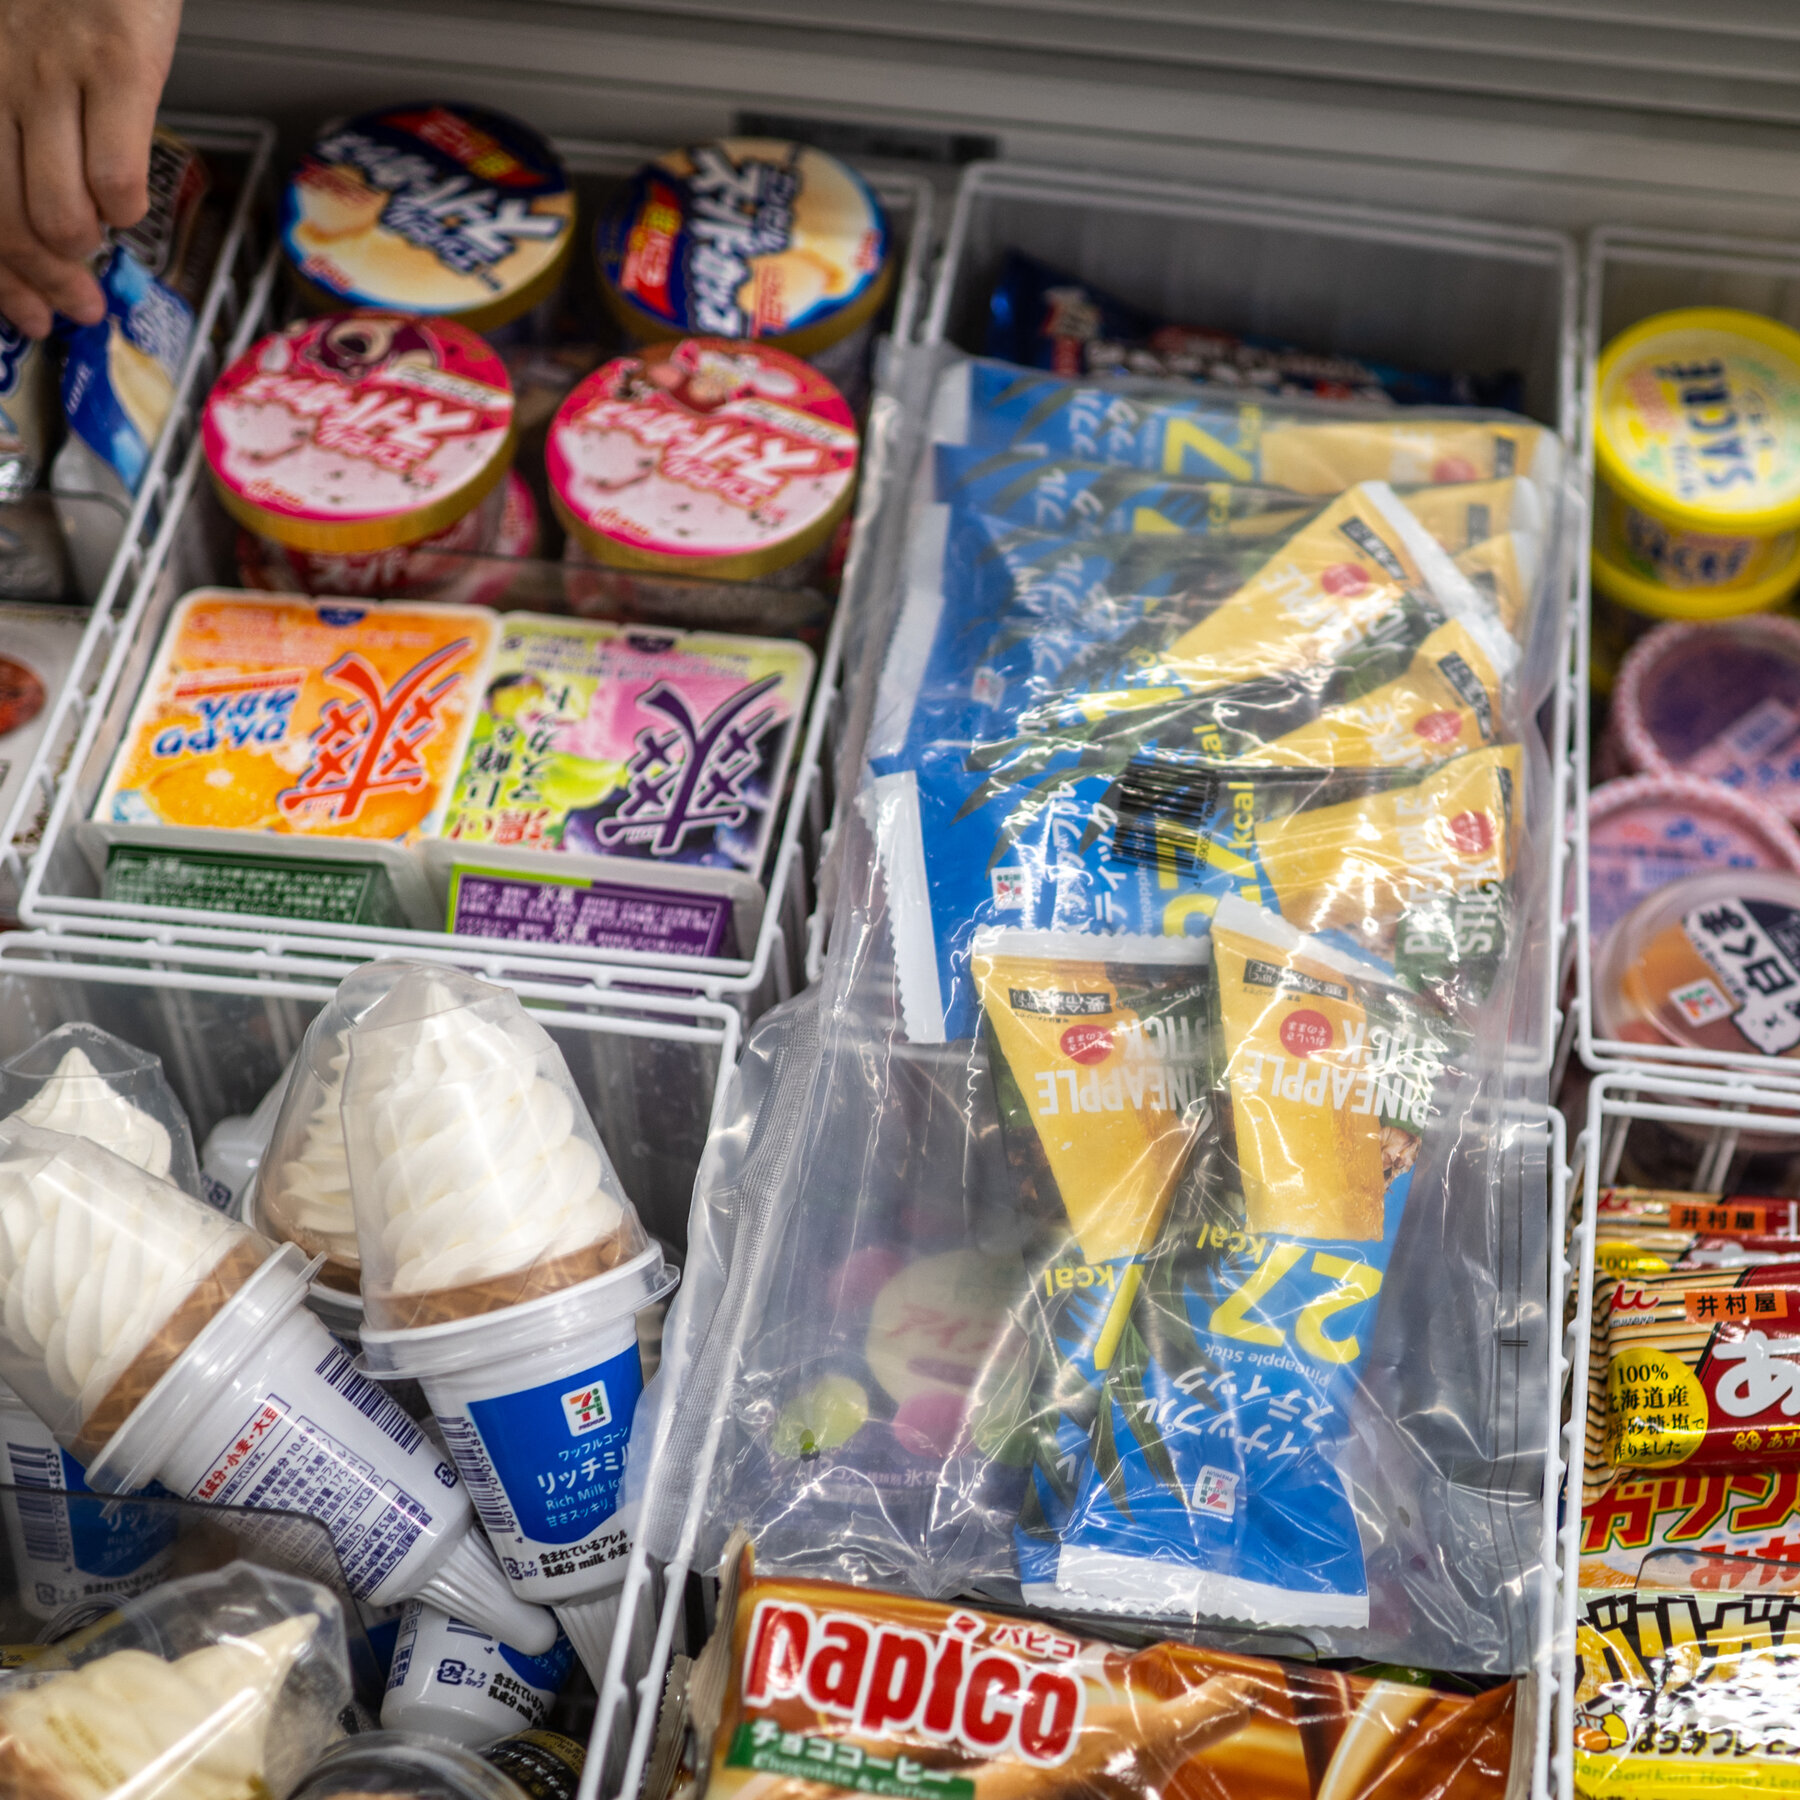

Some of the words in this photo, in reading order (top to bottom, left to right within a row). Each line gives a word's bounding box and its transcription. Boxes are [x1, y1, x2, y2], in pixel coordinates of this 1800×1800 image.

[1162, 418, 1254, 483] 7
[194, 689, 299, 726] みかん
[153, 715, 286, 756] ひんやり
[276, 636, 472, 821] 爽
[507, 685, 570, 804] マスカット
[596, 671, 784, 856] 爽
[449, 807, 550, 846] 濃い!
[1227, 780, 1256, 850] kcal
[1457, 856, 1502, 955] STICK
[1239, 1048, 1431, 1127] PINEAPPLE
[1681, 1208, 1756, 1231] 井村屋
[1196, 1223, 1270, 1266] kcal
[1045, 1264, 1116, 1298] kcal
[1208, 1244, 1385, 1365] 27
[1697, 1293, 1778, 1318] 井村屋
[1203, 1343, 1246, 1364] Stick
[1247, 1350, 1332, 1388] Pineapple
[1618, 1363, 1669, 1385] 100%
[1172, 1367, 1335, 1433] スティック
[194, 1402, 283, 1501] 乳成分・小麦・大豆
[559, 1427, 628, 1462] ワッフルコーン
[1614, 1440, 1682, 1459] 作りました
[545, 1494, 575, 1511] Rich
[578, 1481, 606, 1502] Milk
[543, 1561, 576, 1579] 乳成分
[578, 1555, 604, 1570] milk
[992, 1624, 1080, 1661] パピコ
[746, 1603, 1083, 1764] papico
[752, 1718, 955, 1783] チョココーヒー
